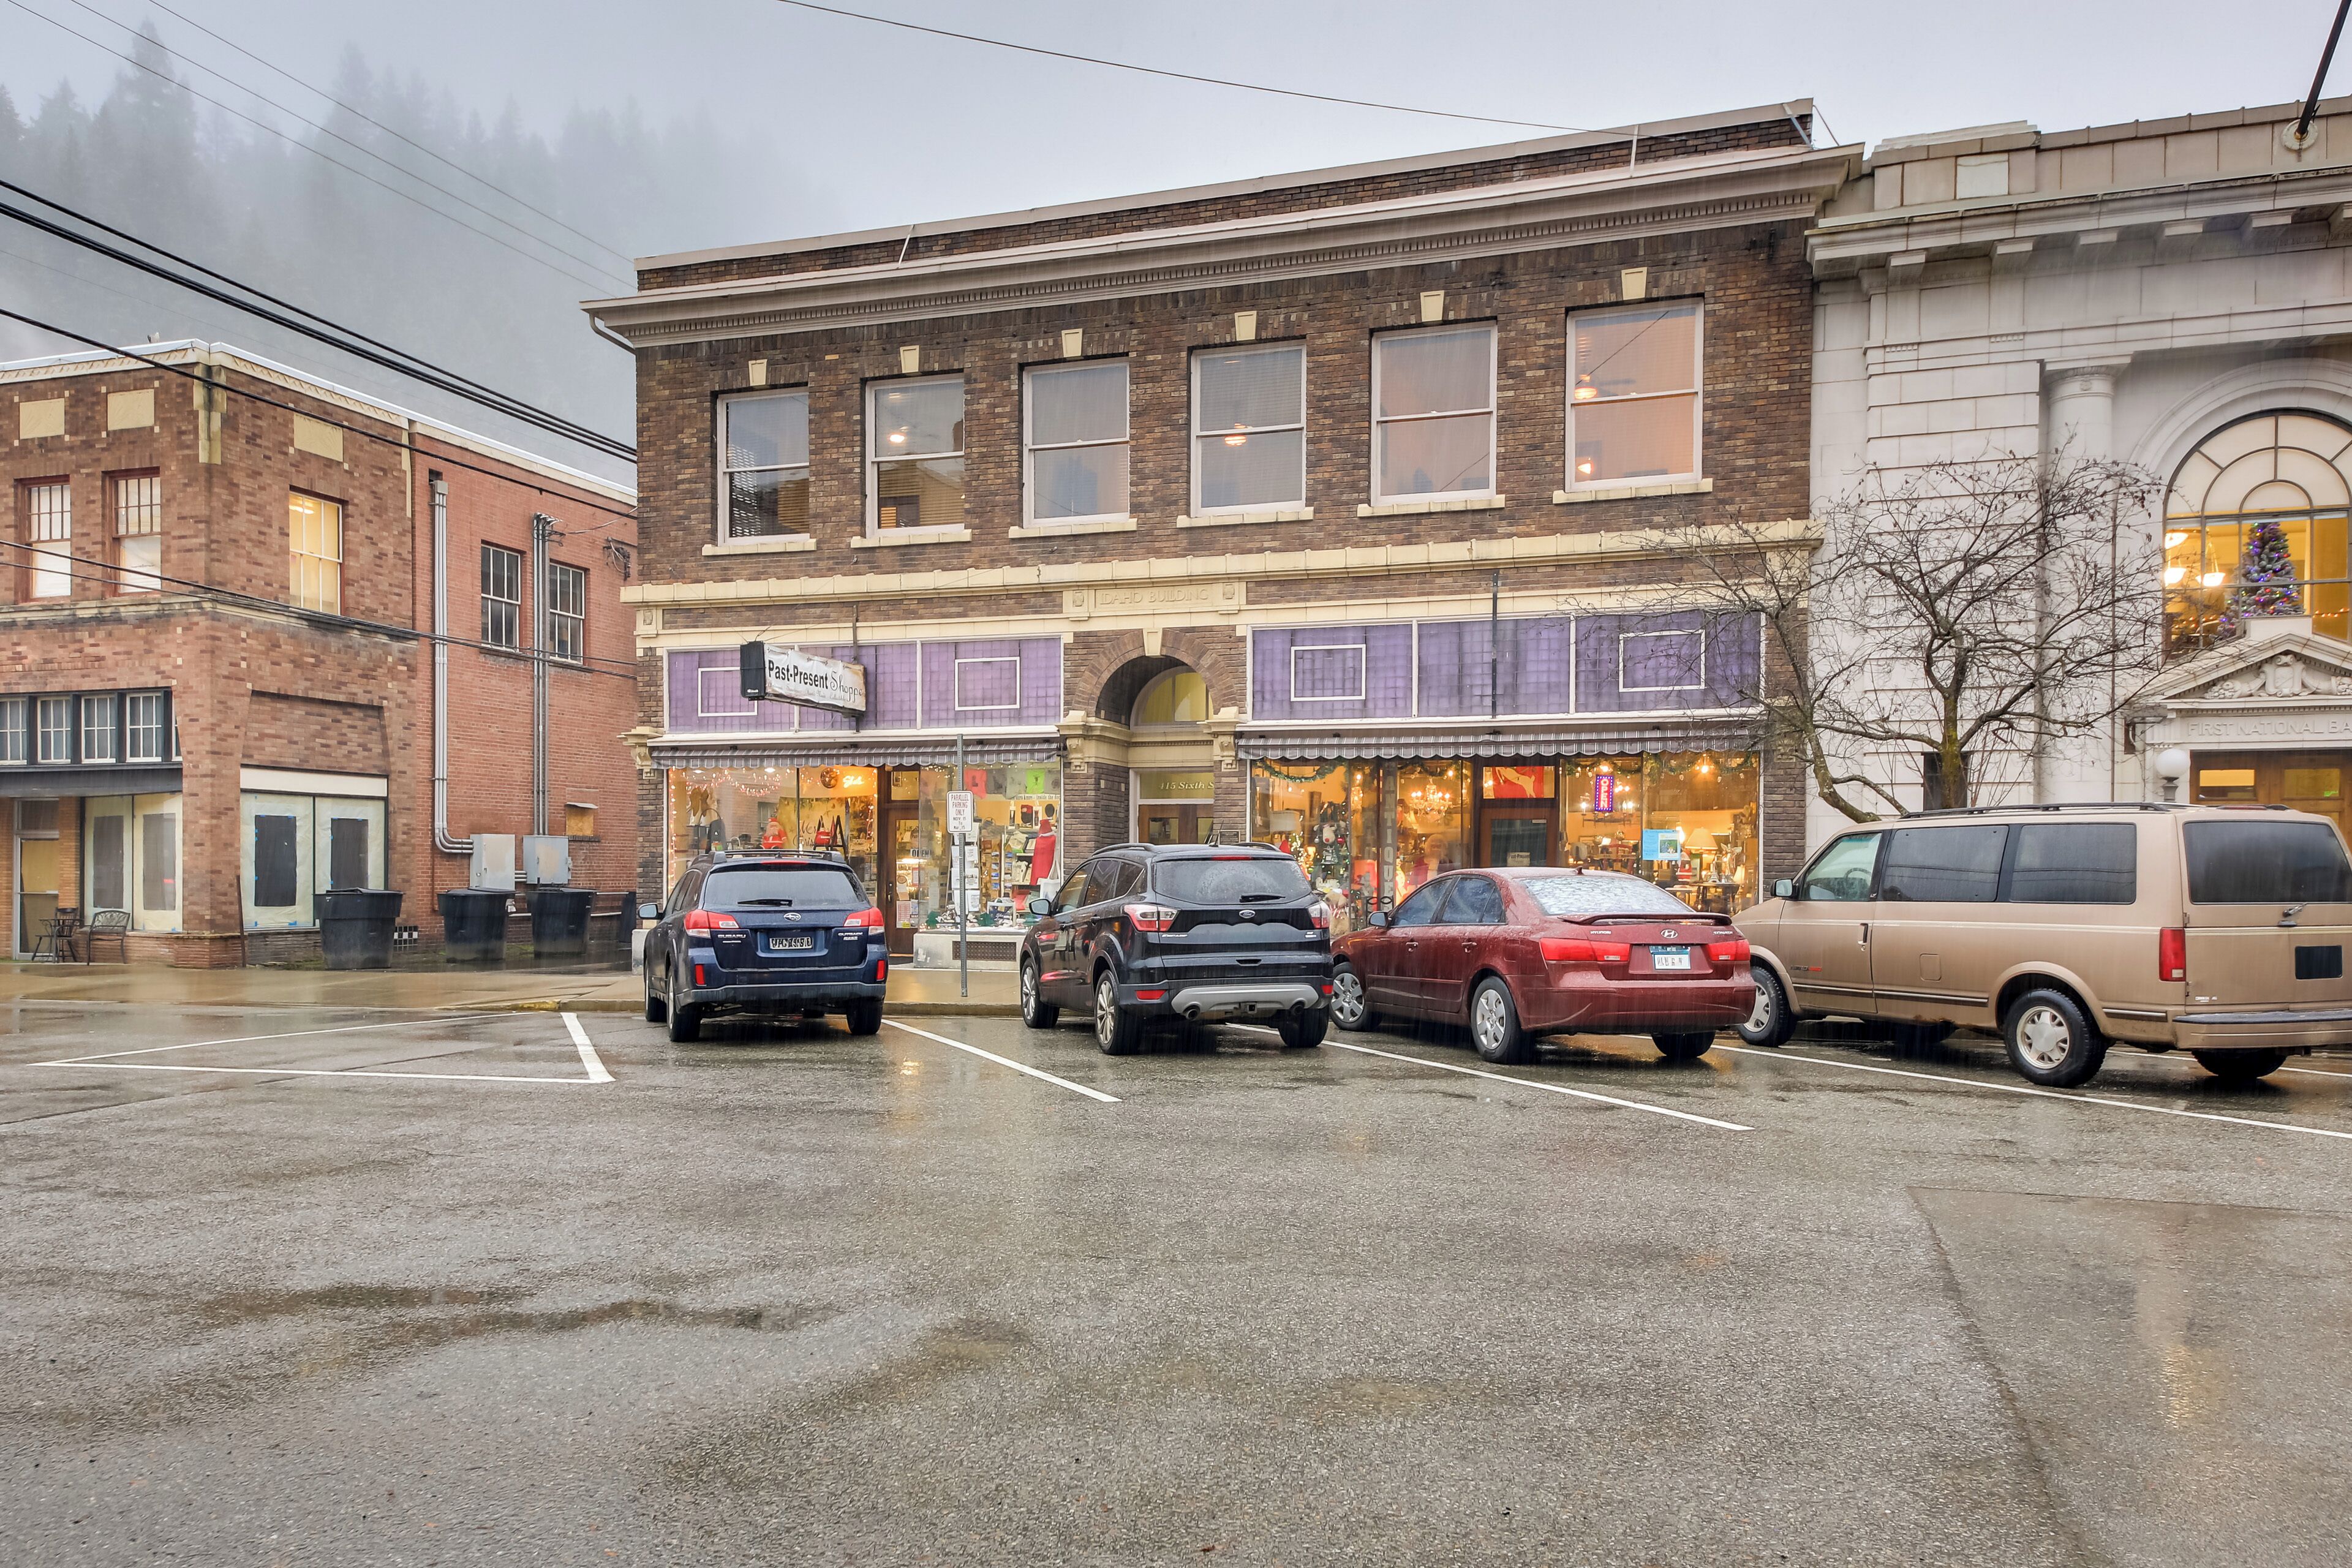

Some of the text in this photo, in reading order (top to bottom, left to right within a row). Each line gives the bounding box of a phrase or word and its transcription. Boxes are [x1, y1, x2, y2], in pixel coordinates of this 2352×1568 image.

[1100, 589, 1209, 605] IDAHO BUILDING
[767, 660, 829, 689] Past-Present
[830, 670, 863, 703] Shoppe
[2188, 722, 2234, 736] FIRST
[2237, 720, 2324, 735] NATIONAL
[1160, 782, 1176, 790] 415
[1178, 781, 1205, 790] Sixth
[1600, 778, 1609, 808] OPEN
